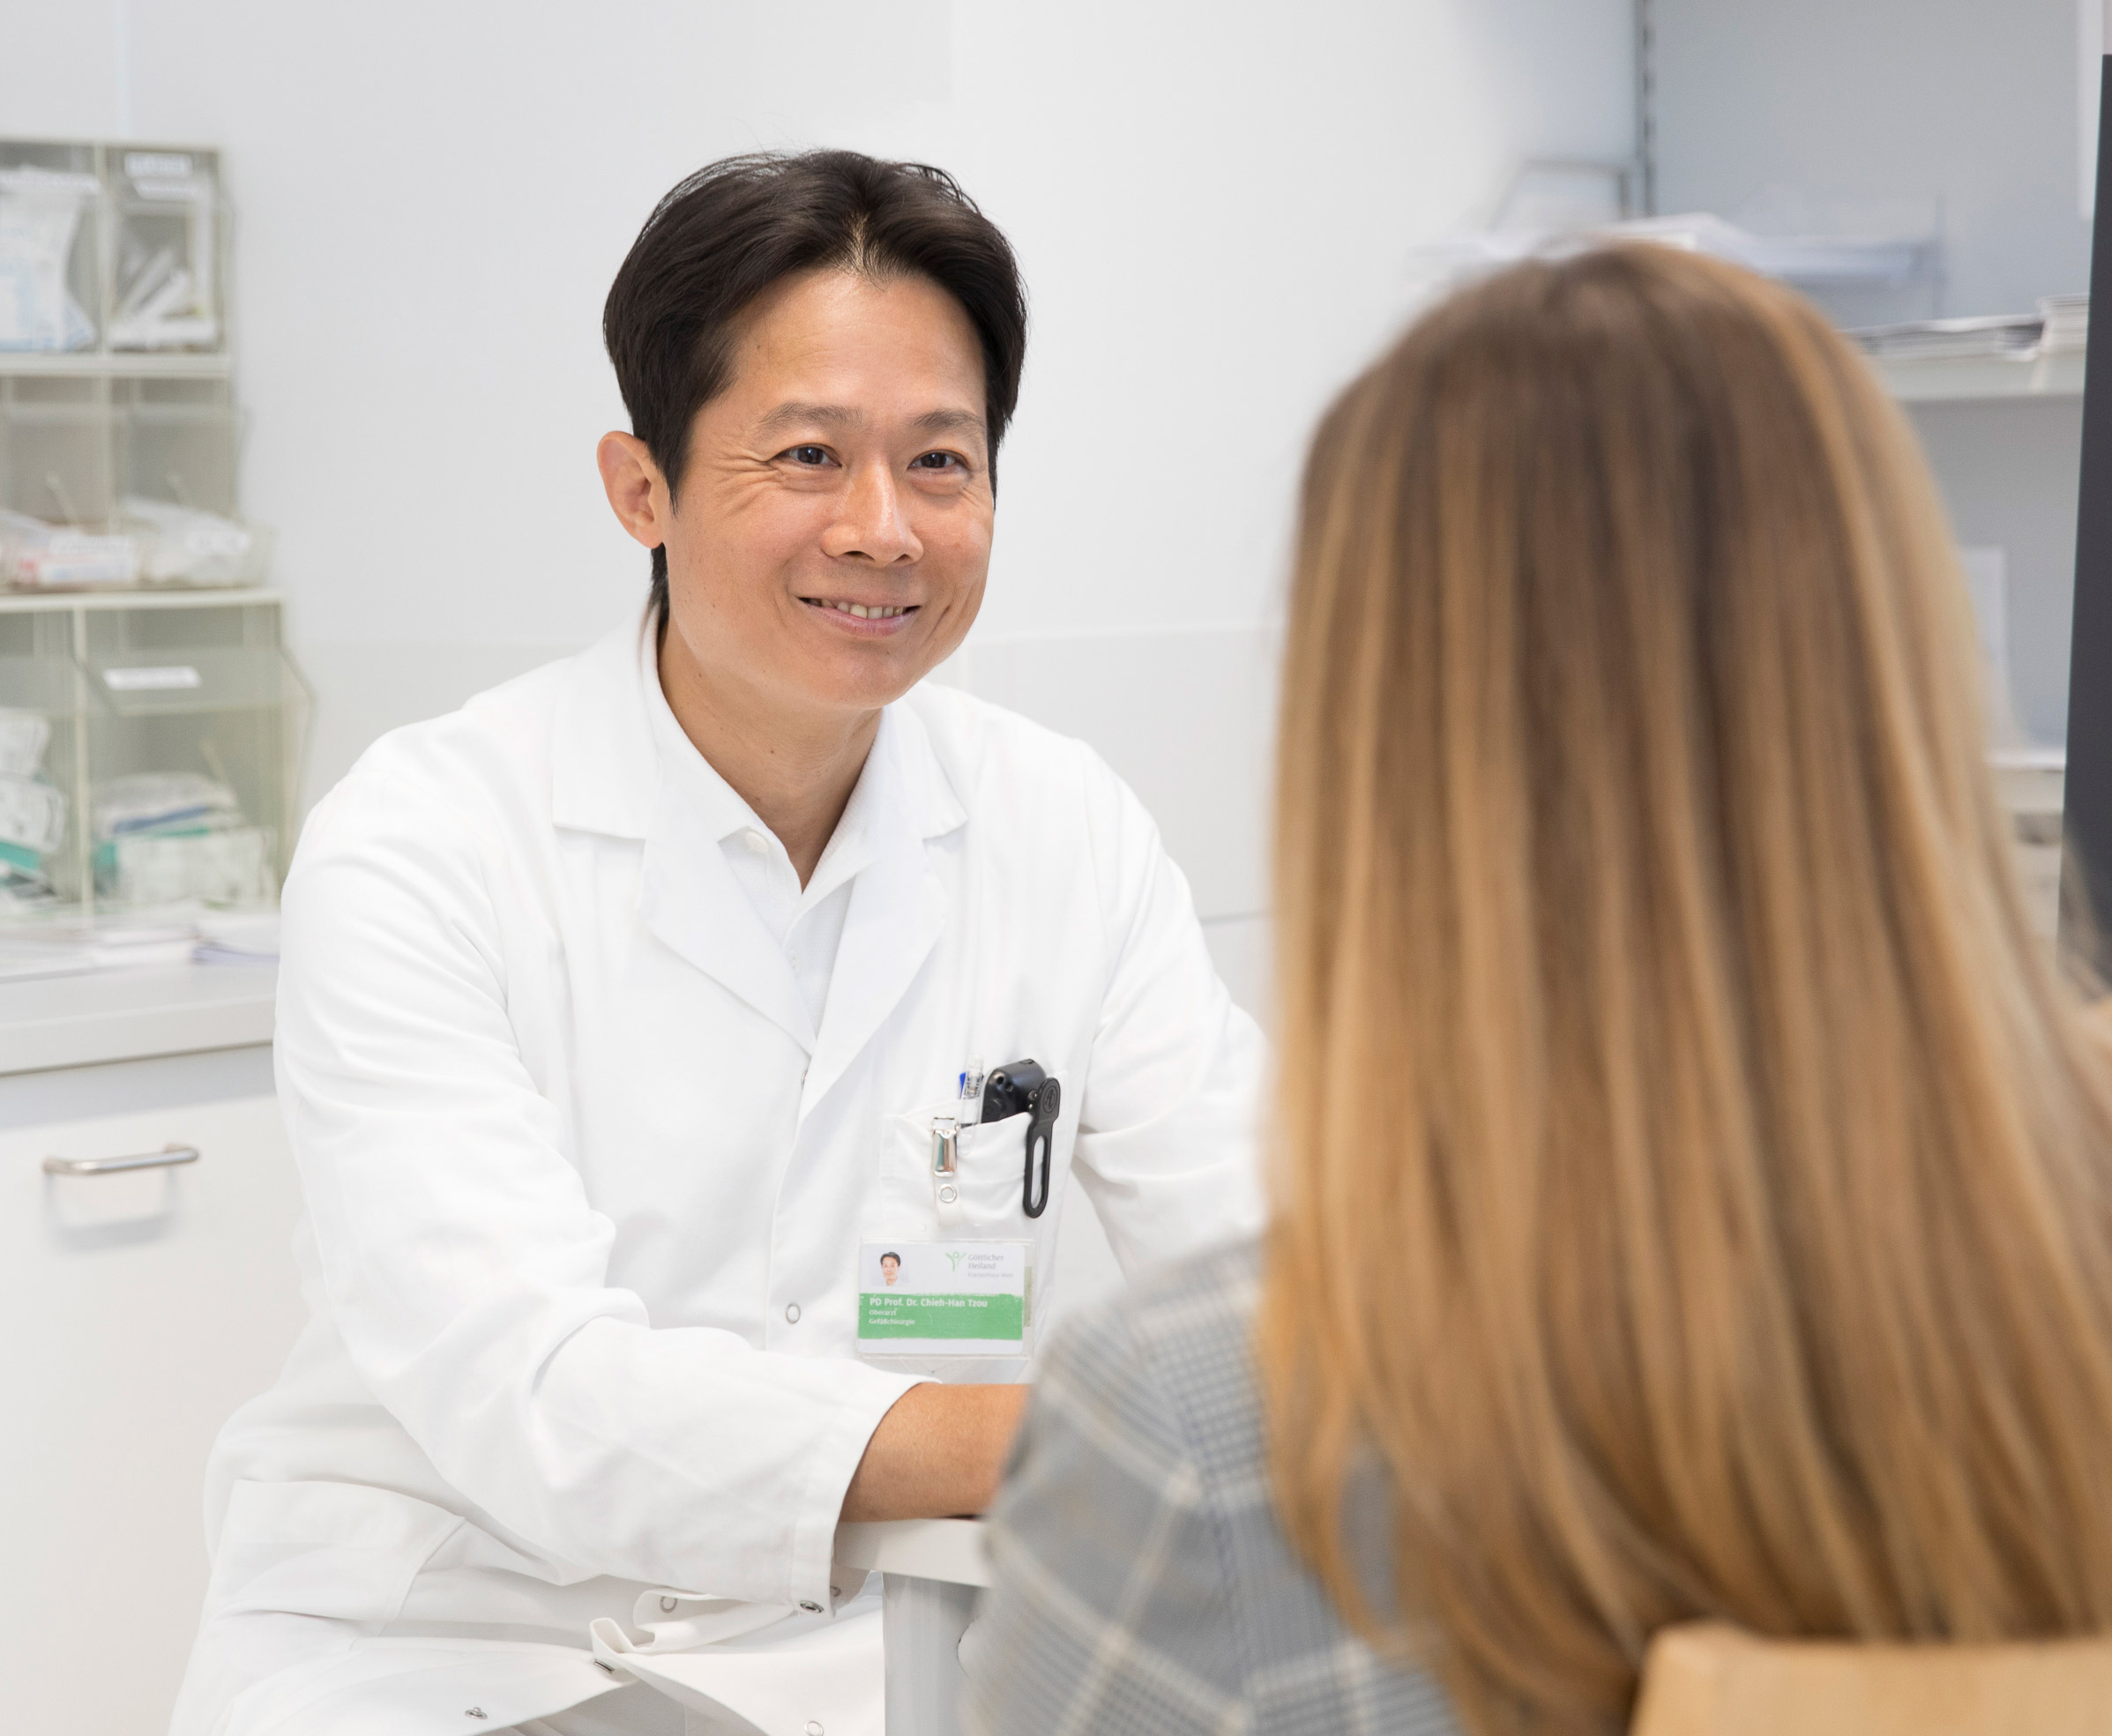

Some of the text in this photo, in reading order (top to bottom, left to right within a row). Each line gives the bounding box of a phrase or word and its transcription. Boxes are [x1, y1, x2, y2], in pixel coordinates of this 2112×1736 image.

[869, 1297, 989, 1308] PD Prof. Dr. Chieh-Han Tzou
